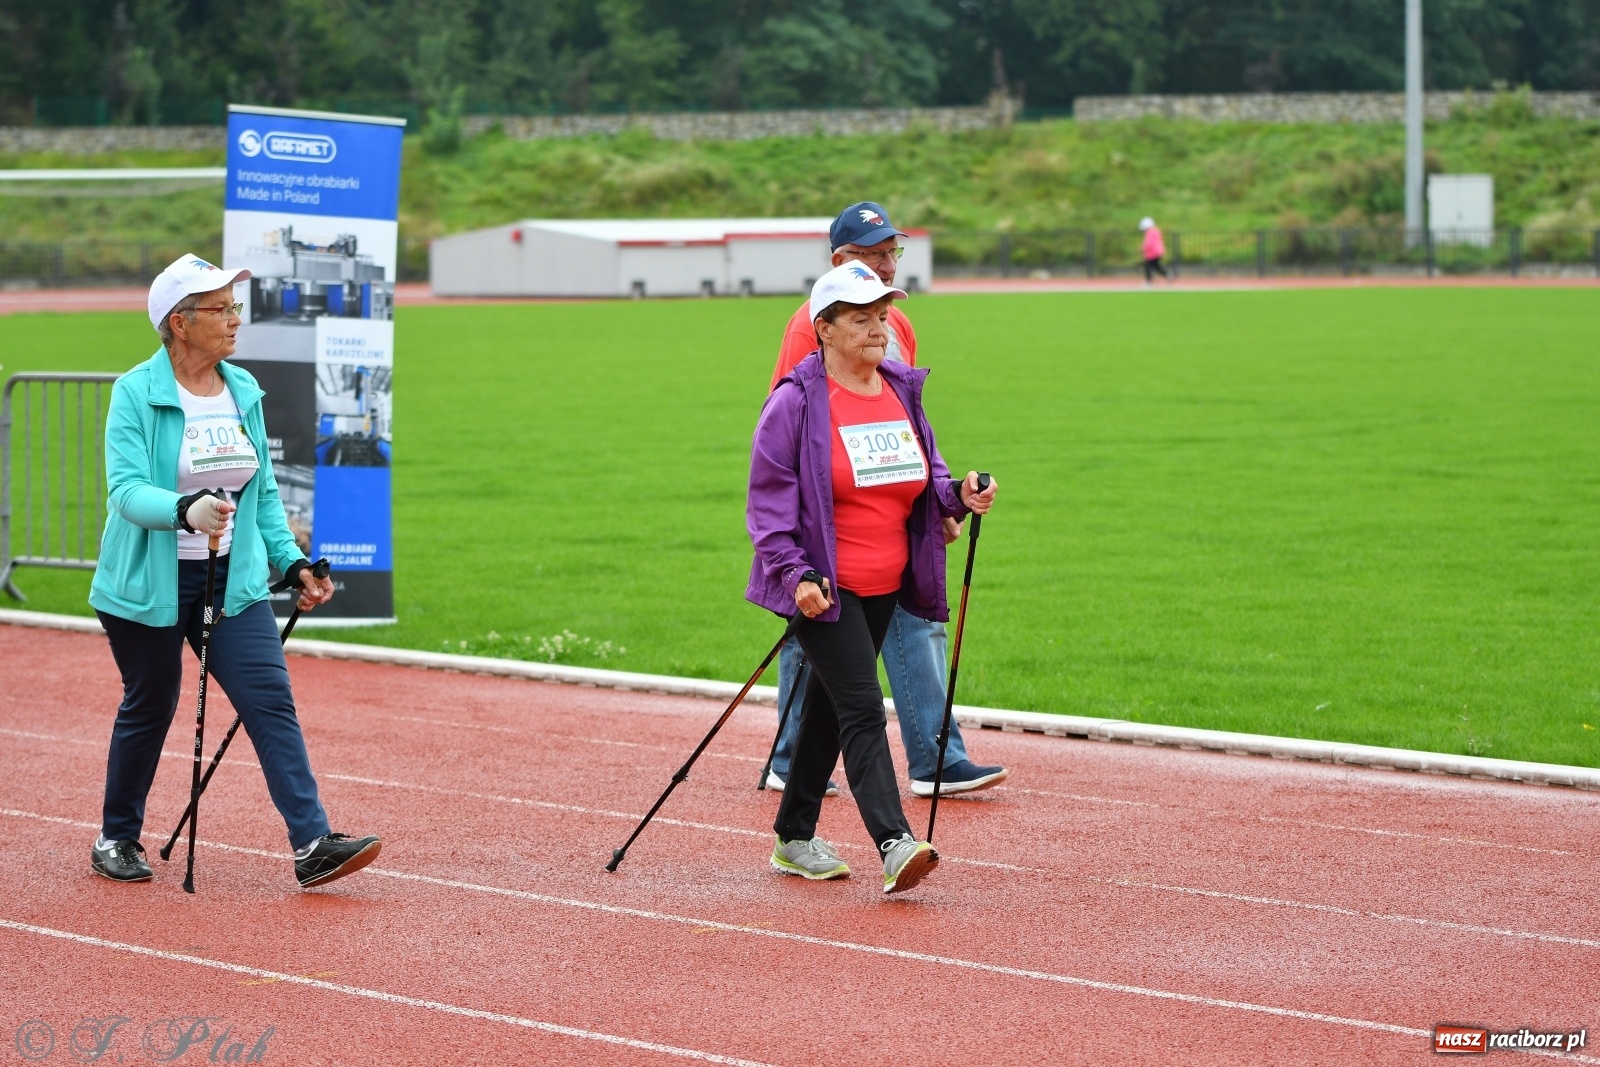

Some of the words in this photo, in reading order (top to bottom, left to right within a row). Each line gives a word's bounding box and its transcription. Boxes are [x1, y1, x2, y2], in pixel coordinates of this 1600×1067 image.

[237, 169, 305, 187] Innowacyjne
[306, 174, 360, 190] obrabiarki
[236, 187, 270, 201] Made
[272, 189, 282, 201] in
[284, 190, 320, 205] Poland
[326, 337, 367, 347] TOKARKI
[326, 349, 385, 360] KARUZELOWE
[205, 426, 240, 447] 101
[863, 432, 900, 453] 100
[319, 543, 377, 554] OBRABIARKI
[197, 679, 205, 718] WALKING
